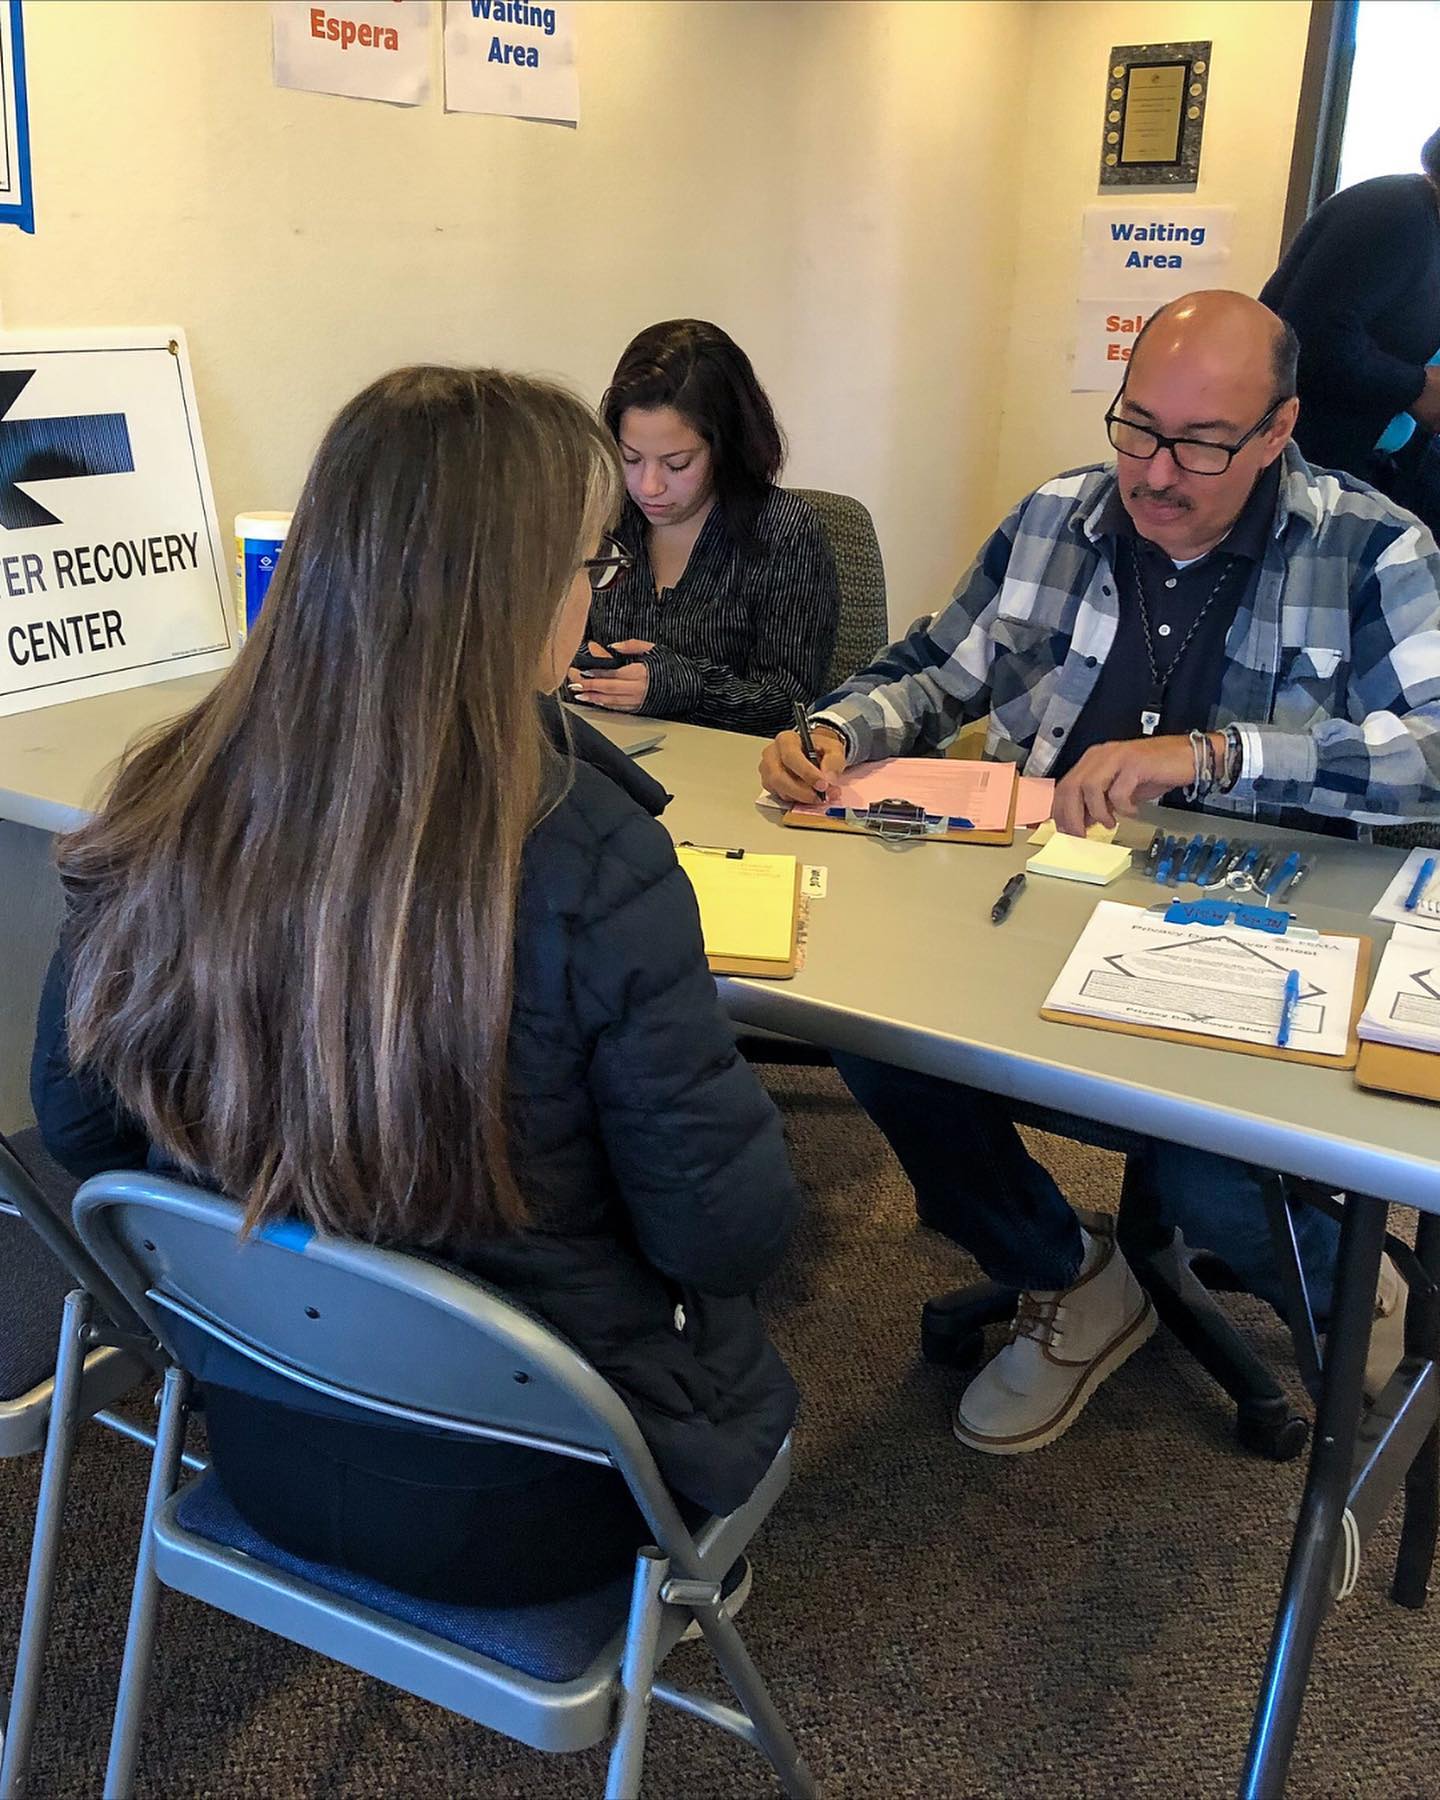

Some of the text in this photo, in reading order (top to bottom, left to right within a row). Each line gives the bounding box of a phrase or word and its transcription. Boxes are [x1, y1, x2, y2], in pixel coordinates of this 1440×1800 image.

[310, 8, 399, 50] Espera
[471, 0, 556, 35] Waiting
[488, 37, 539, 67] Area
[1111, 223, 1206, 246] Waiting
[1125, 250, 1183, 269] Area
[1105, 315, 1146, 333] Sal
[1106, 344, 1133, 362] Es
[0, 531, 198, 598] ER RECOVERY
[8, 609, 126, 666] CENTER
[1131, 925, 1183, 937] Privacy
[1274, 945, 1318, 956] Sheet
